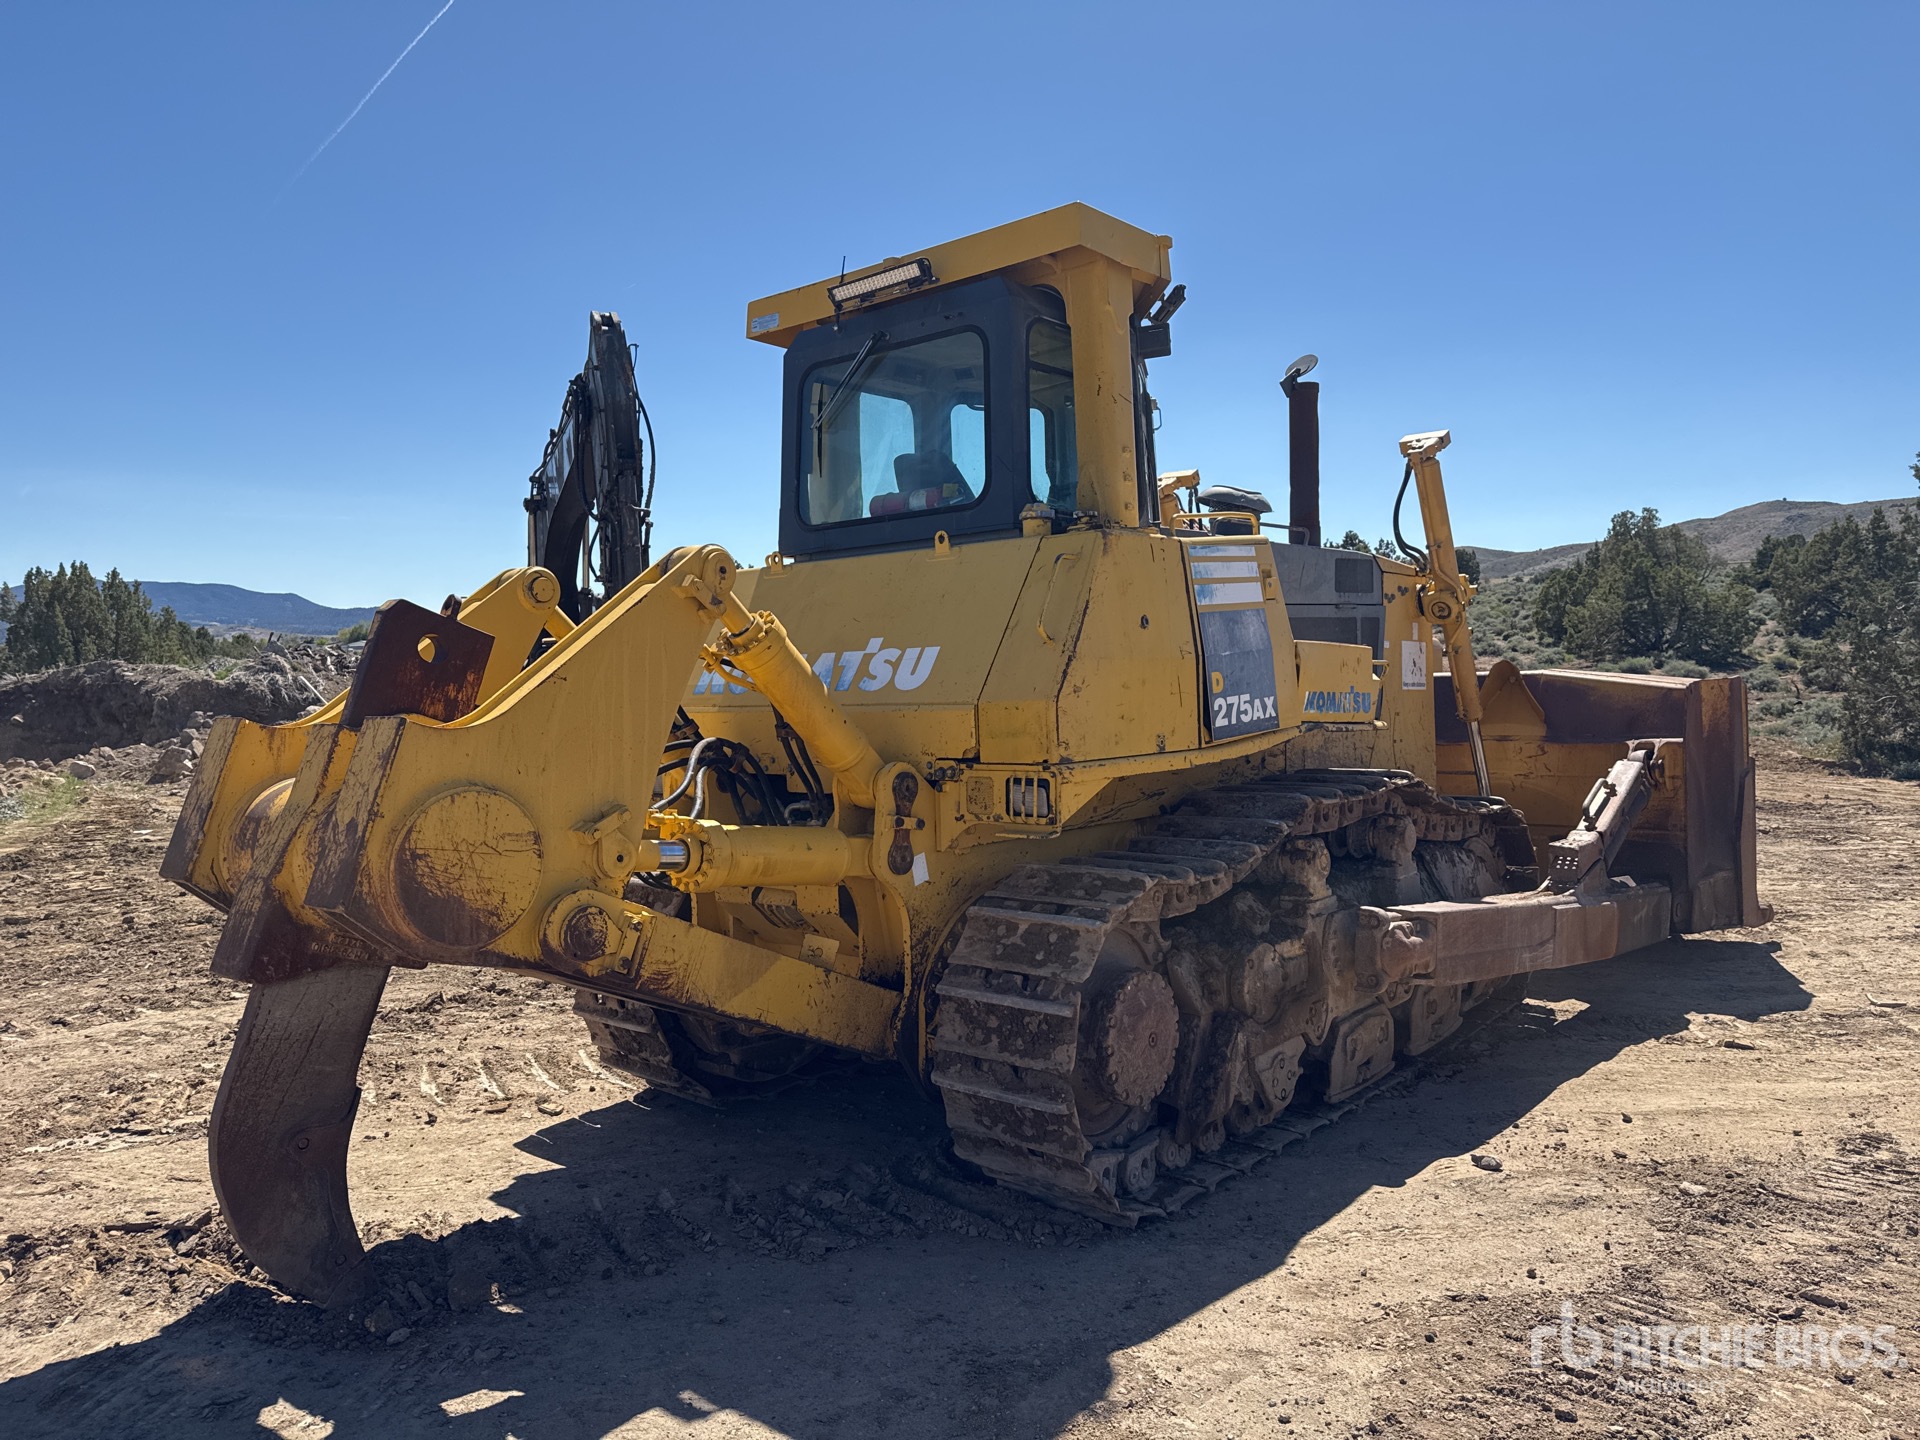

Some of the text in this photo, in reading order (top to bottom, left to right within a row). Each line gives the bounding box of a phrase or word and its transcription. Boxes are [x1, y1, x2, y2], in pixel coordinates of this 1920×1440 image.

[693, 637, 940, 695] KOATSU
[1211, 671, 1224, 694] D
[1213, 693, 1277, 728] 275AX
[1303, 685, 1371, 714] KOMATSU
